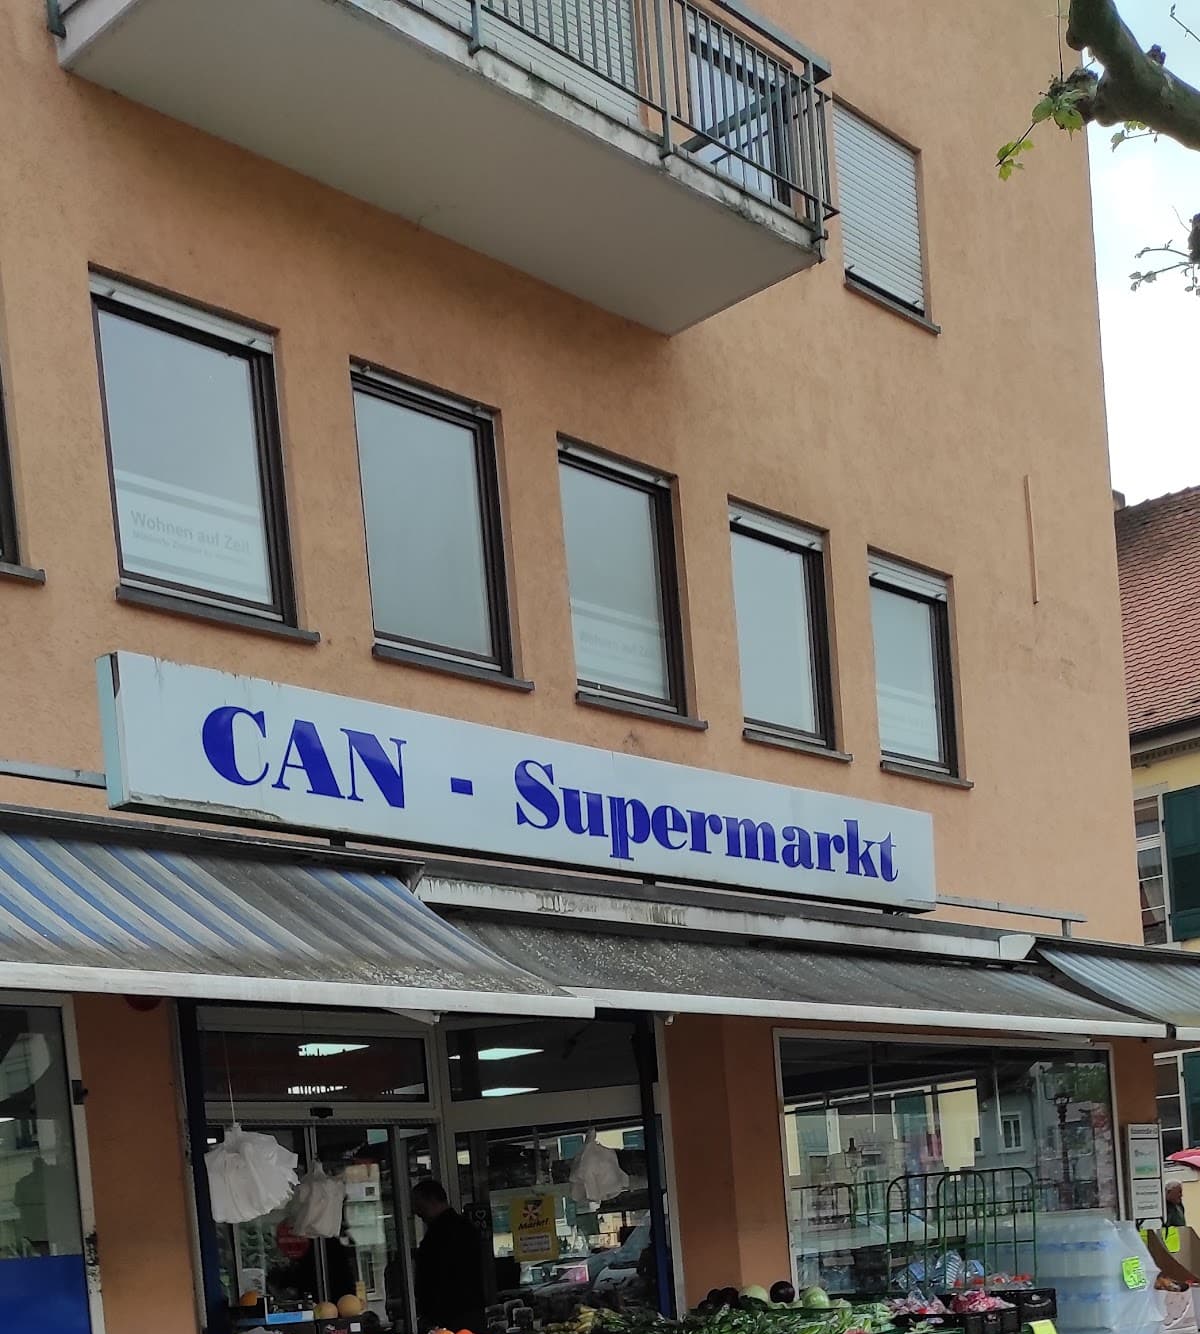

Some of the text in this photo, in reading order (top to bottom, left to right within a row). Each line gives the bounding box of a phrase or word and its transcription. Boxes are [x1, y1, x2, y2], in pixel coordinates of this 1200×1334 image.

[130, 509, 193, 540] Wohnen
[198, 530, 220, 547] auf
[202, 706, 899, 882] CAN - Supermarkt
